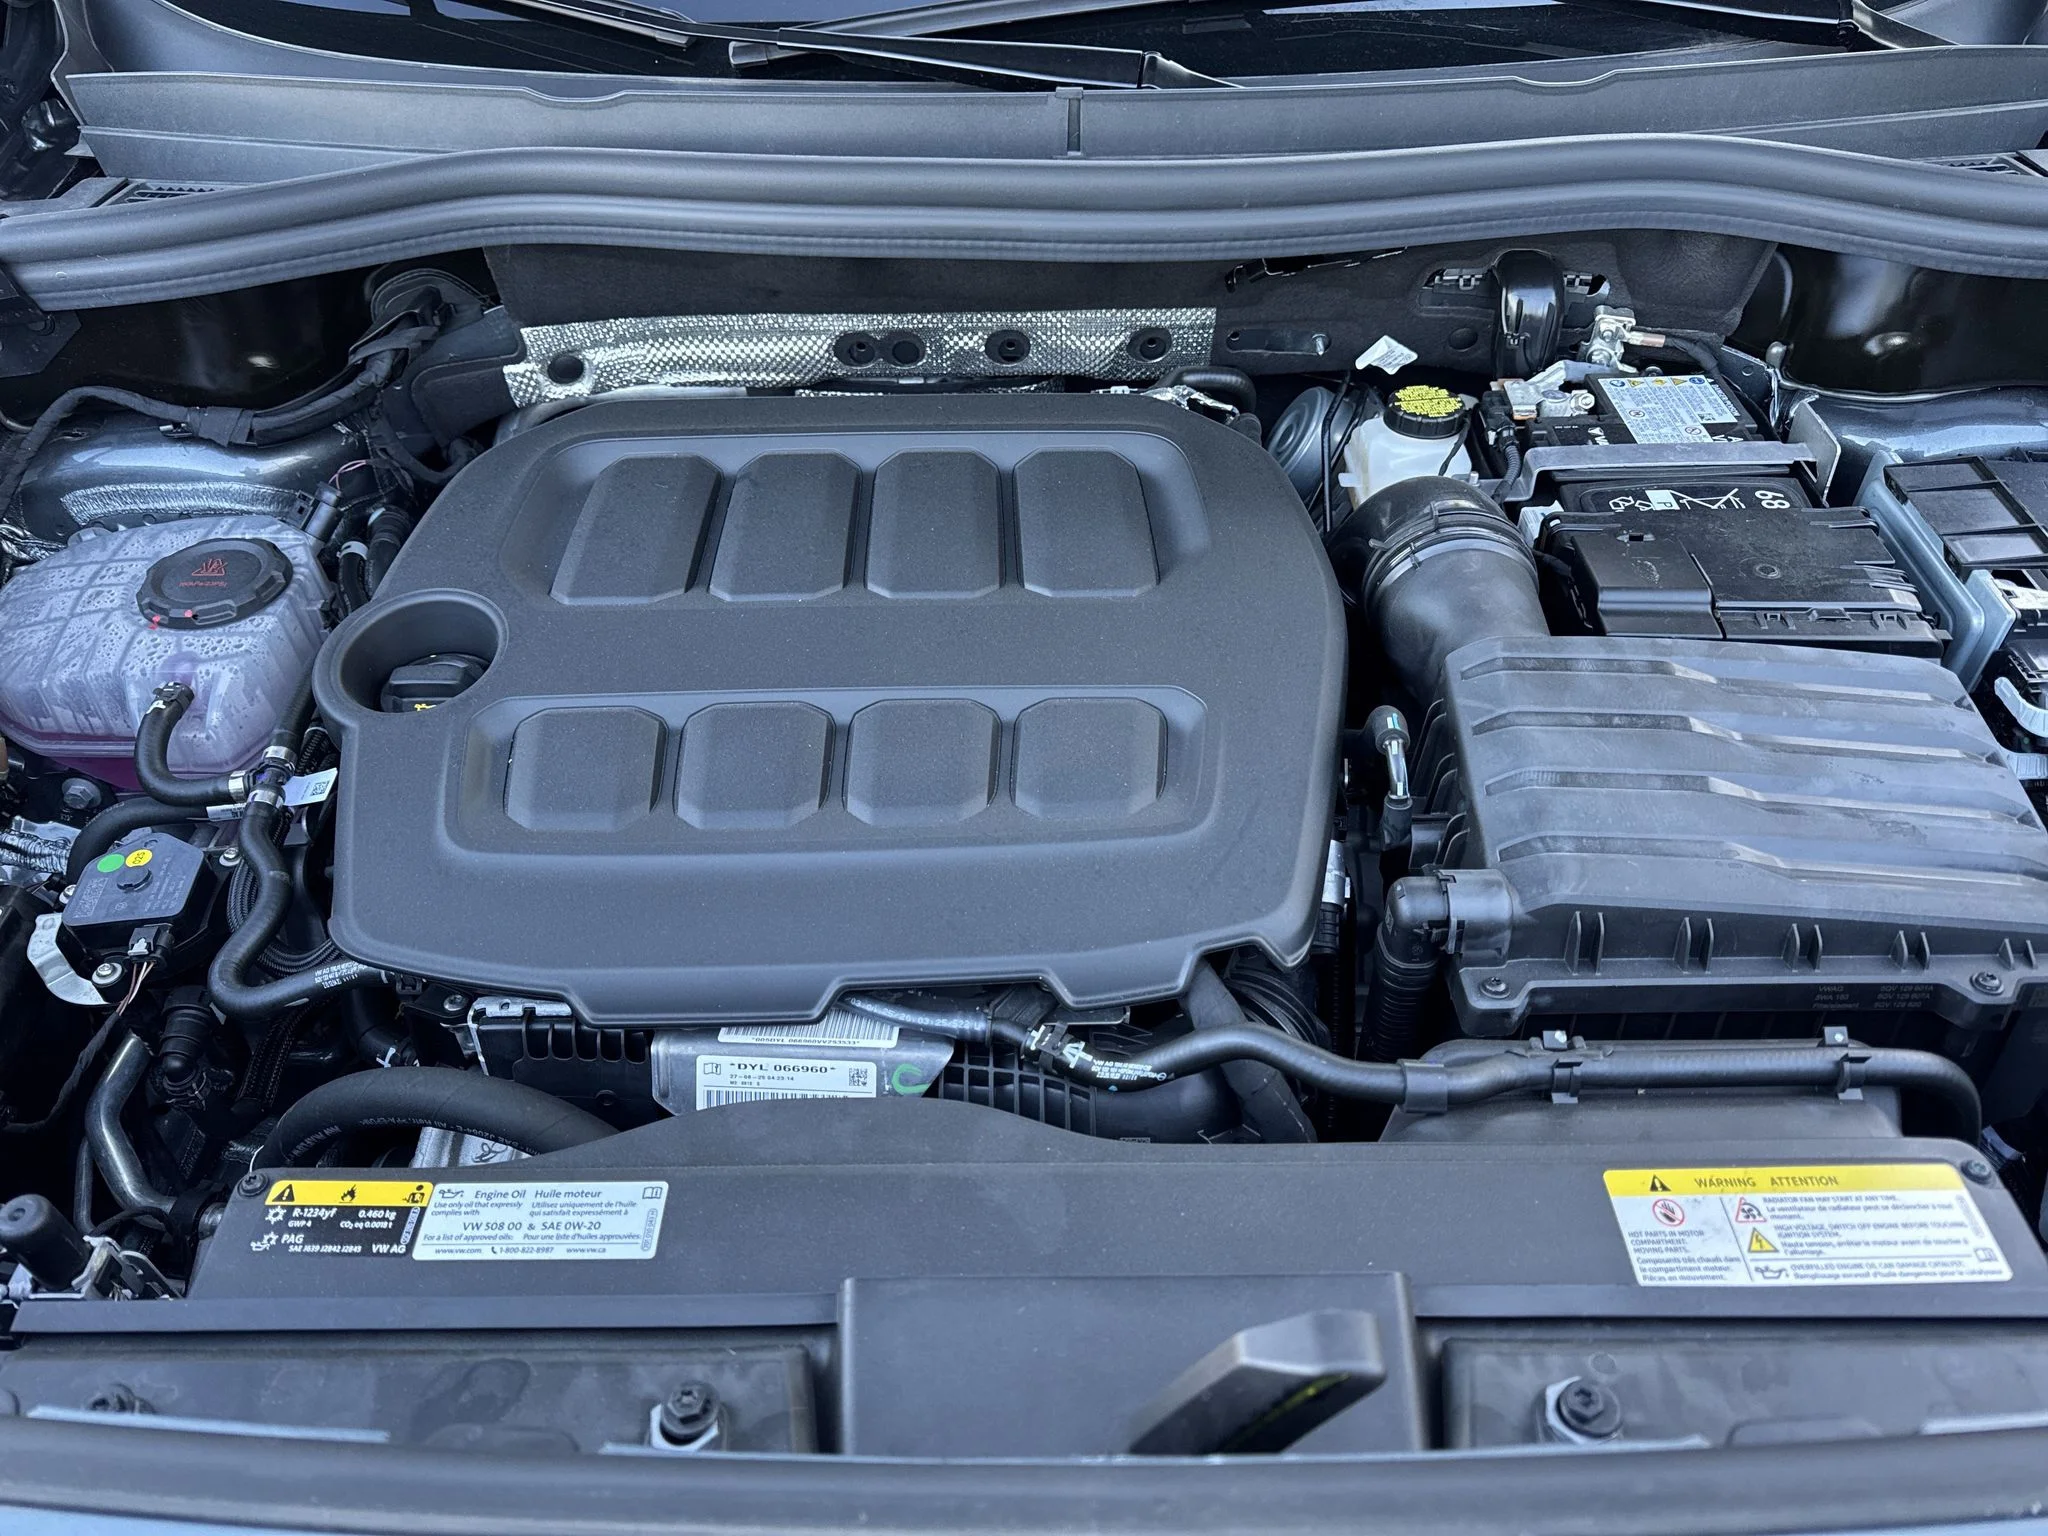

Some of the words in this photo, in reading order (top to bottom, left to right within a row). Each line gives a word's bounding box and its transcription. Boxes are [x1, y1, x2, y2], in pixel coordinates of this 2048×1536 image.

[1694, 1177, 1756, 1188] WARNING
[1770, 1176, 1839, 1187] ATTENTION
[475, 1190, 509, 1200] Engine
[512, 1190, 526, 1198] Oil
[535, 1190, 562, 1198] Huile
[490, 1201, 523, 1209] expressly
[292, 1208, 337, 1219] R-1234yf
[358, 1210, 384, 1218] 0.460
[384, 1210, 396, 1220] kg
[463, 1222, 482, 1231] VW
[484, 1222, 505, 1230] 508
[507, 1222, 522, 1230] 00
[541, 1222, 562, 1230] SAE
[564, 1222, 601, 1230] 0W-20
[281, 1235, 304, 1244] PAG
[372, 1244, 389, 1253] VW
[390, 1244, 406, 1254] AG
[1637, 1257, 1681, 1265] Composants
